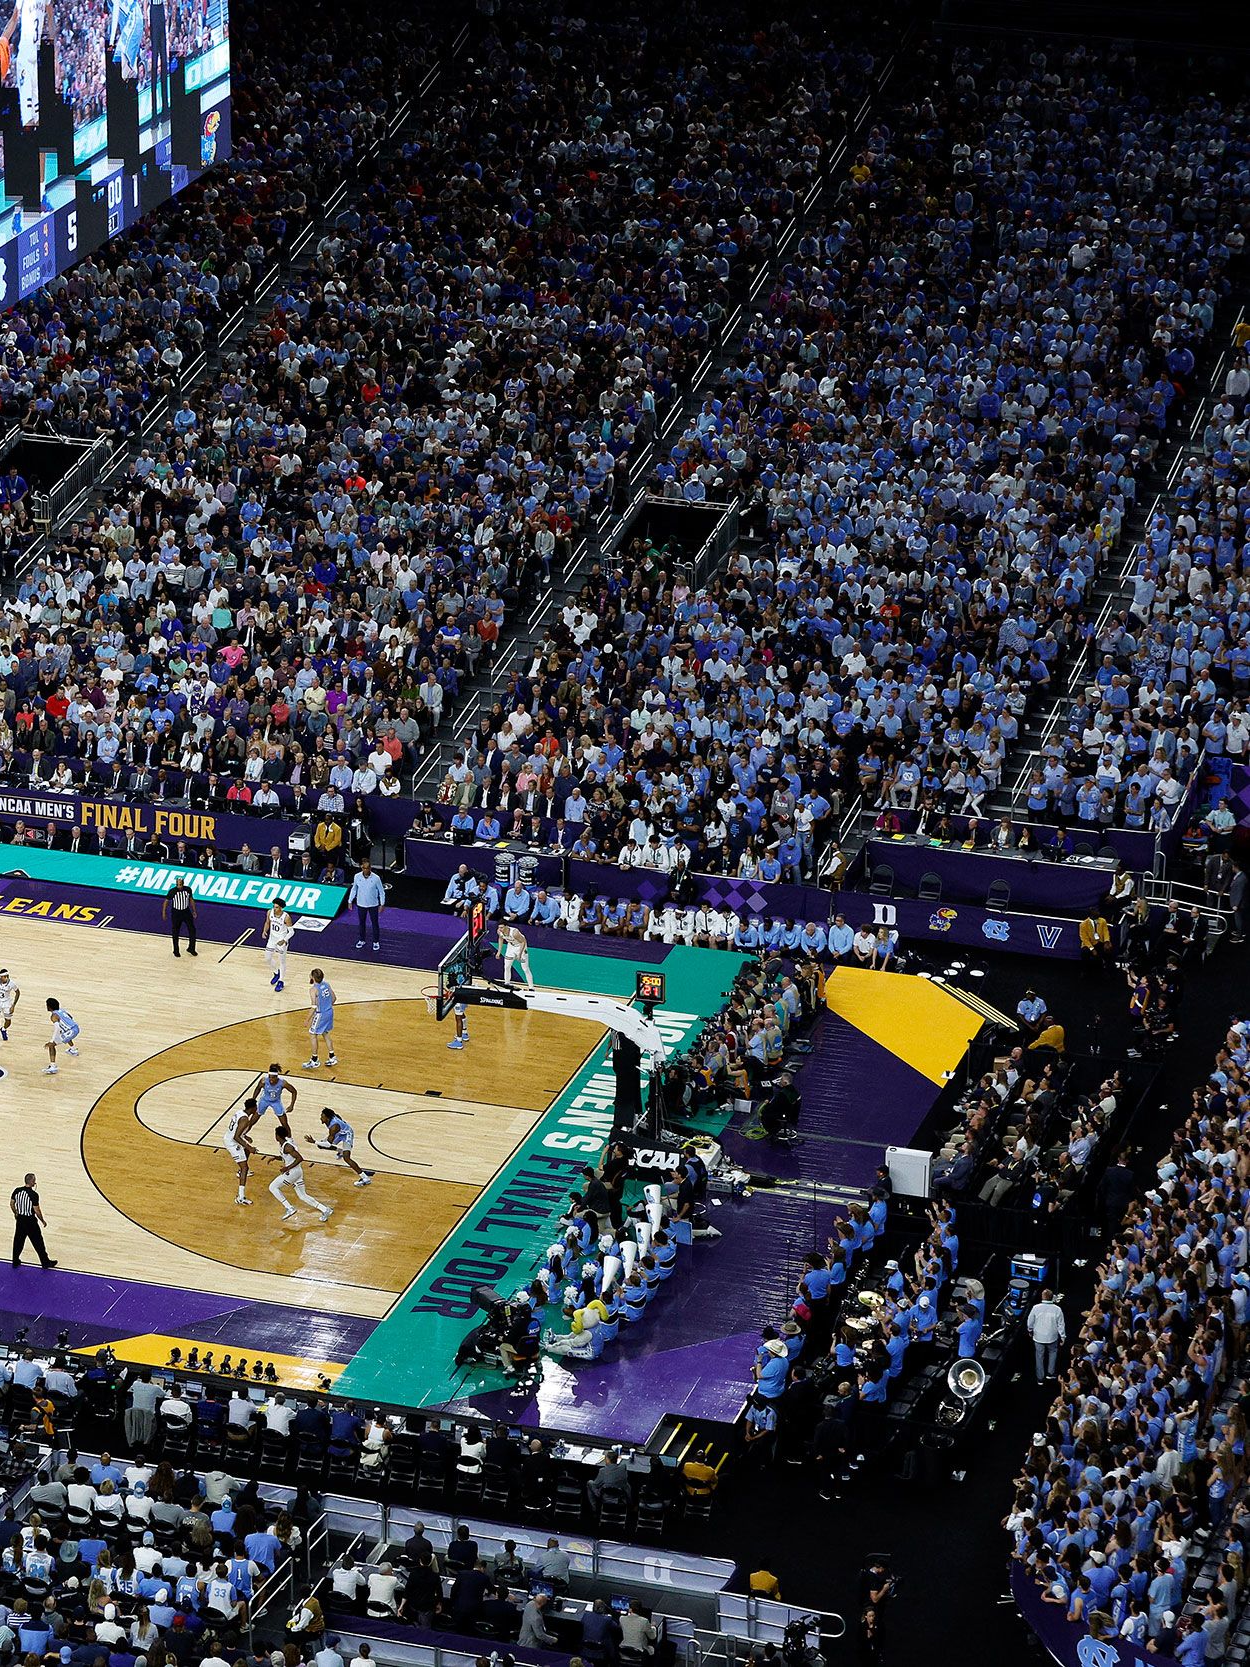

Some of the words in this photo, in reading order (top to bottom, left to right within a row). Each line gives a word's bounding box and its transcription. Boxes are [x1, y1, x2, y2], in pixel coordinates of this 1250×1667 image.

[66, 211, 78, 252] 5
[35, 802, 75, 819] MEN'S
[81, 801, 148, 832] FINAL
[154, 810, 216, 841] FOUR
[271, 924, 280, 933] 10
[1037, 925, 1063, 949] V
[0, 991, 5, 999] 3
[643, 985, 659, 997] 21
[479, 996, 504, 1006] SPALDING
[473, 1153, 588, 1234] FINAL
[411, 1239, 525, 1321] FOUR
[236, 1568, 242, 1581] 1
[119, 1580, 134, 1594] 35
[214, 1587, 227, 1598] 33
